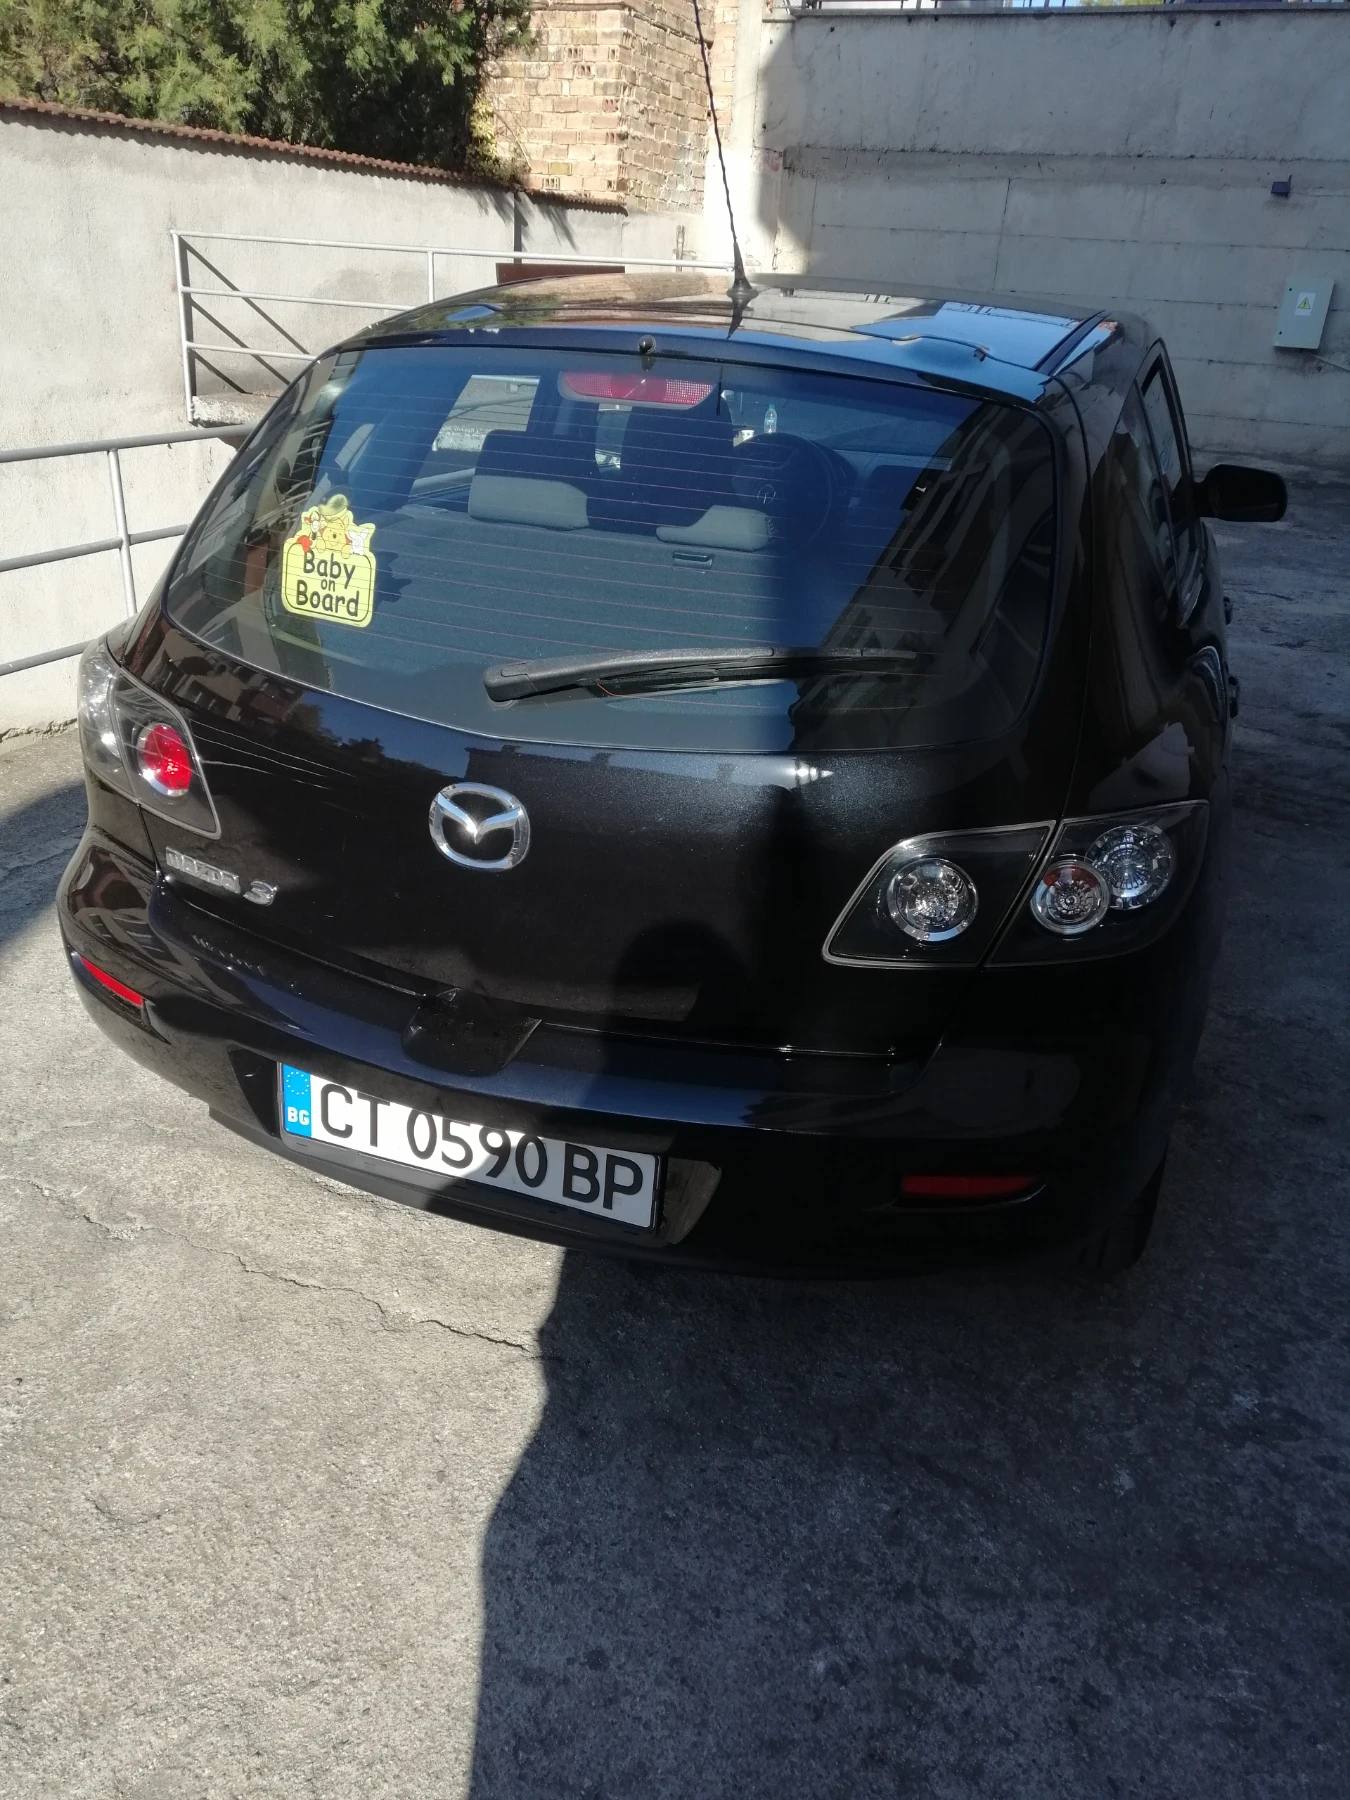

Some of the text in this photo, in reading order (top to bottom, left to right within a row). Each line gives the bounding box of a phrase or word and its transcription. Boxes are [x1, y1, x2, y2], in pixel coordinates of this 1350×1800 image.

[303, 551, 355, 589] Baby
[320, 578, 336, 592] on
[296, 579, 360, 617] Board
[243, 880, 278, 906] 3
[287, 1108, 310, 1127] BG
[320, 1084, 643, 1210] CT 0590 BP
